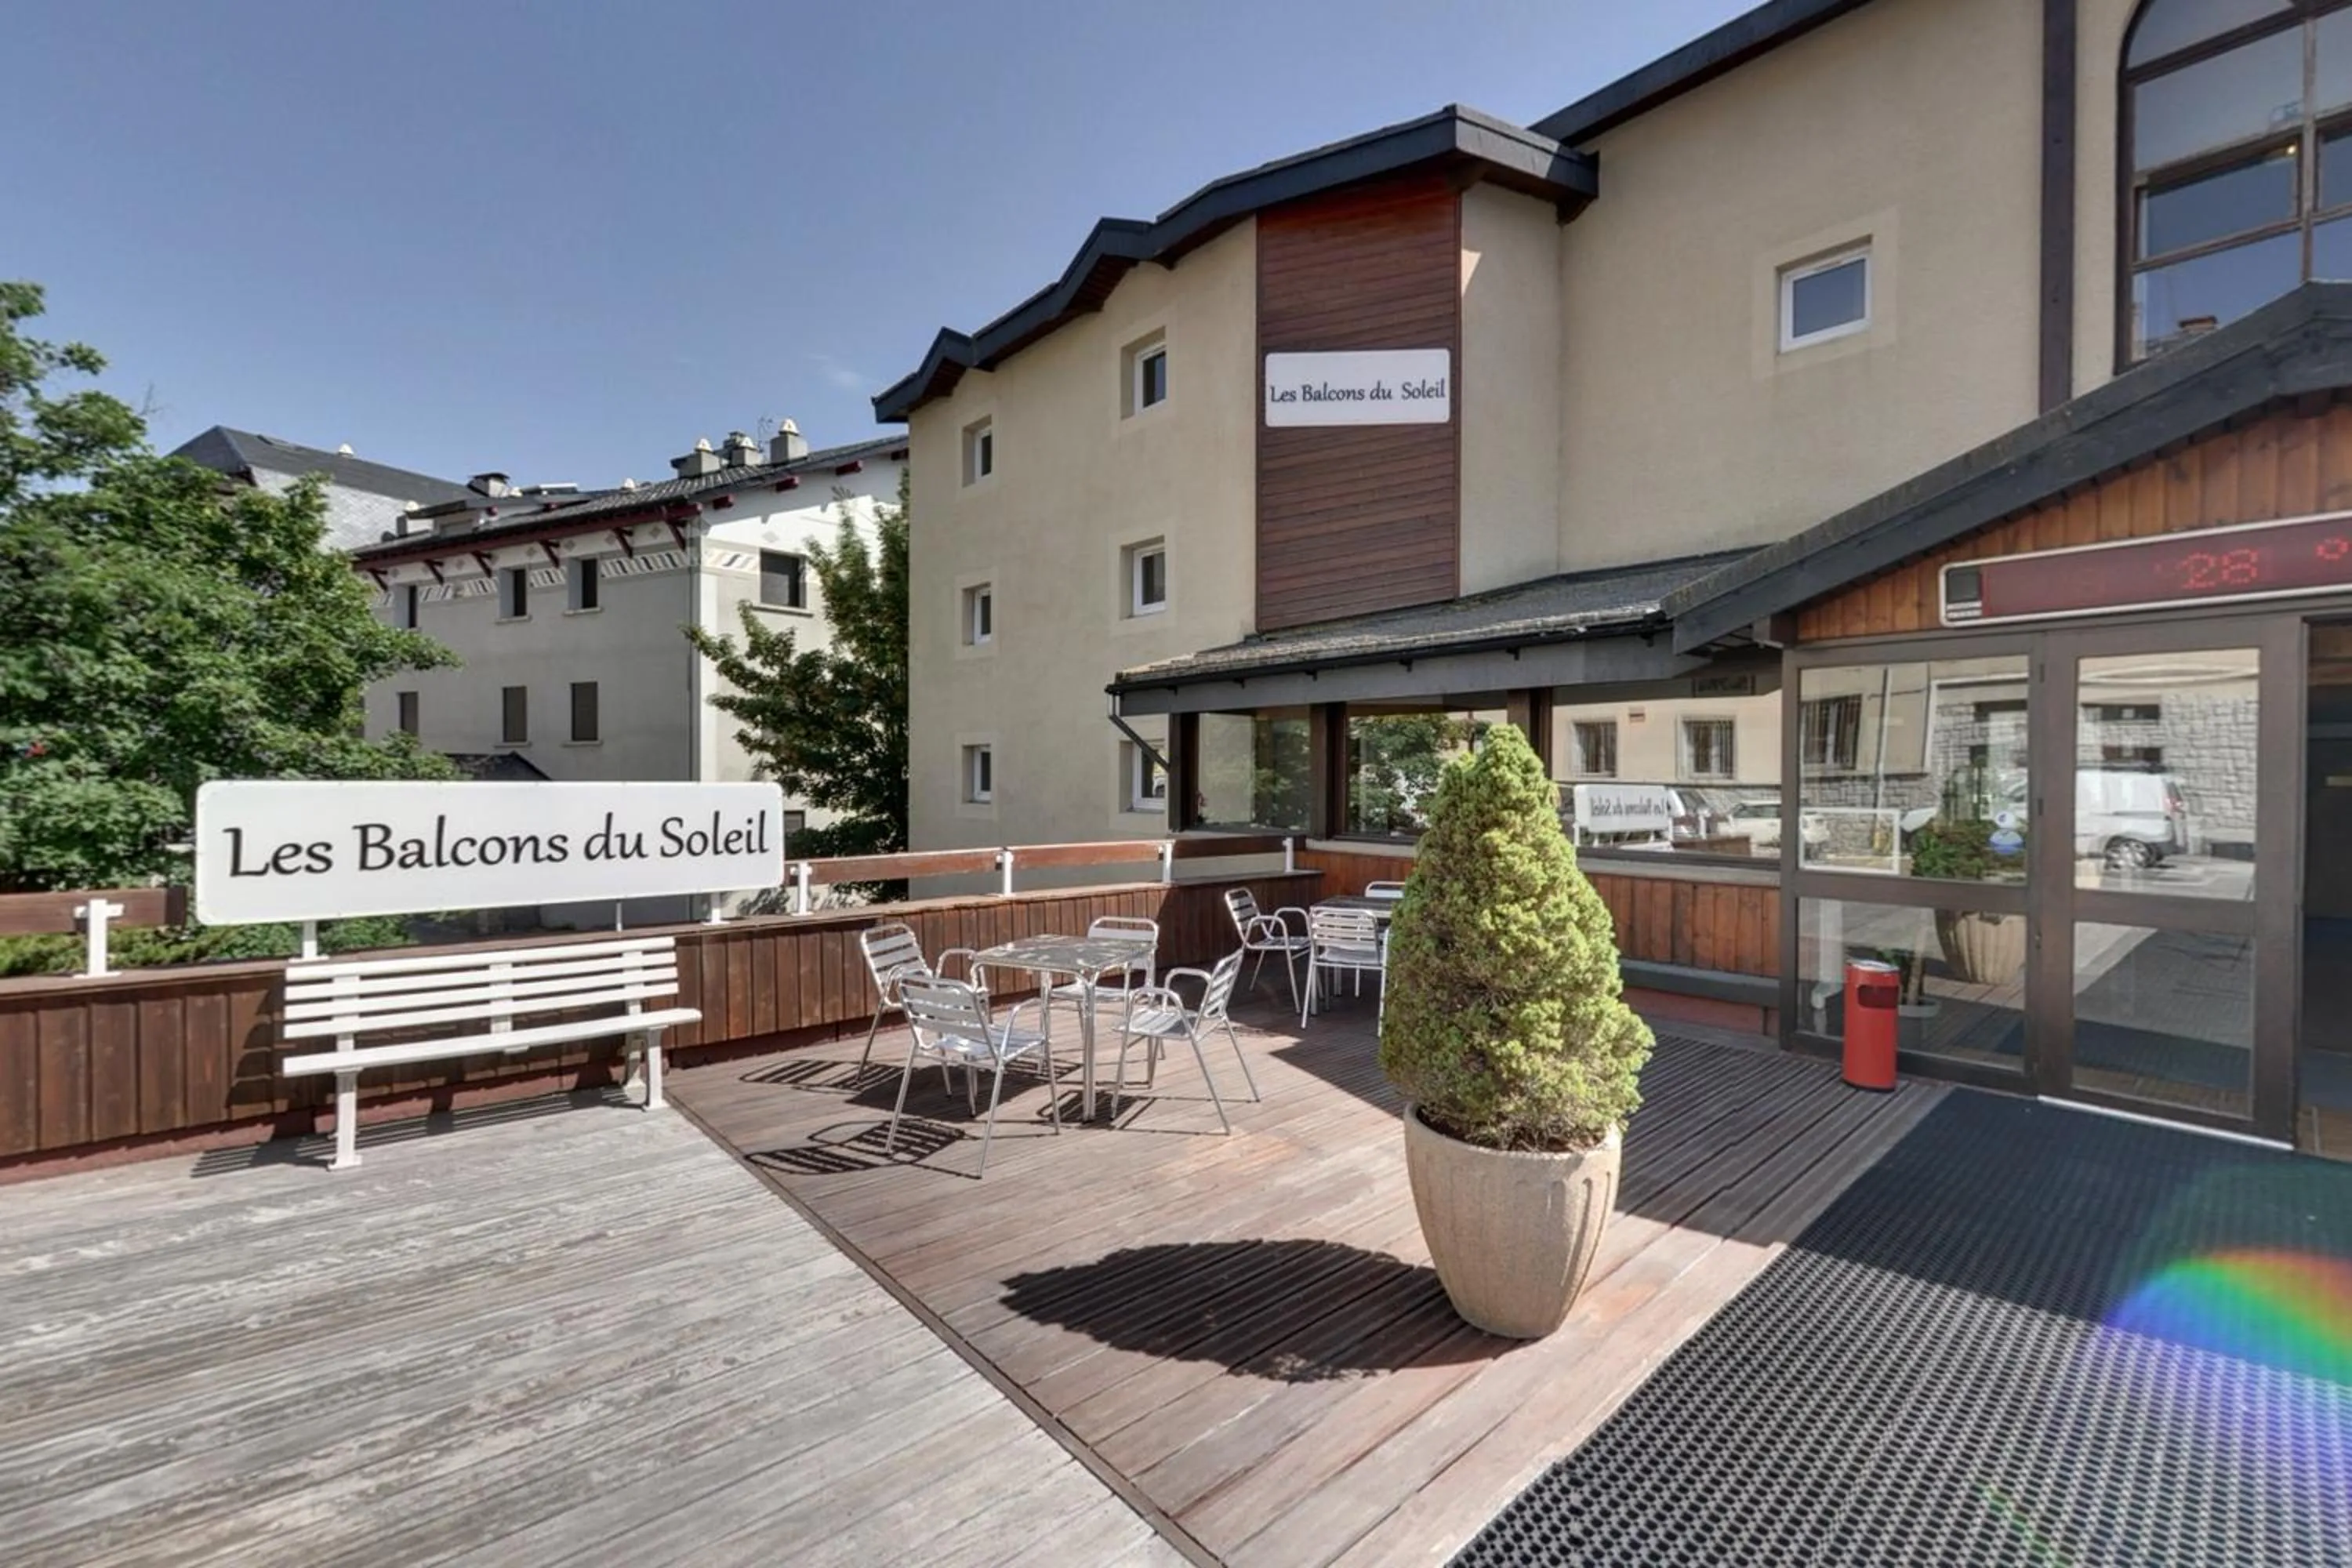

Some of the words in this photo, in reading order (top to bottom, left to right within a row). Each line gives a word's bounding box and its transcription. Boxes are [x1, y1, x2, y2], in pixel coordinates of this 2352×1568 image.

[1270, 385, 1297, 403] Les
[1301, 382, 1366, 402] Balcons
[1370, 380, 1392, 401] du
[1402, 377, 1446, 400] Soleil
[2180, 549, 2258, 589] 28
[223, 826, 333, 877] Les
[352, 815, 569, 872] Balcons
[584, 811, 648, 861] du
[660, 809, 768, 858] Soleil
